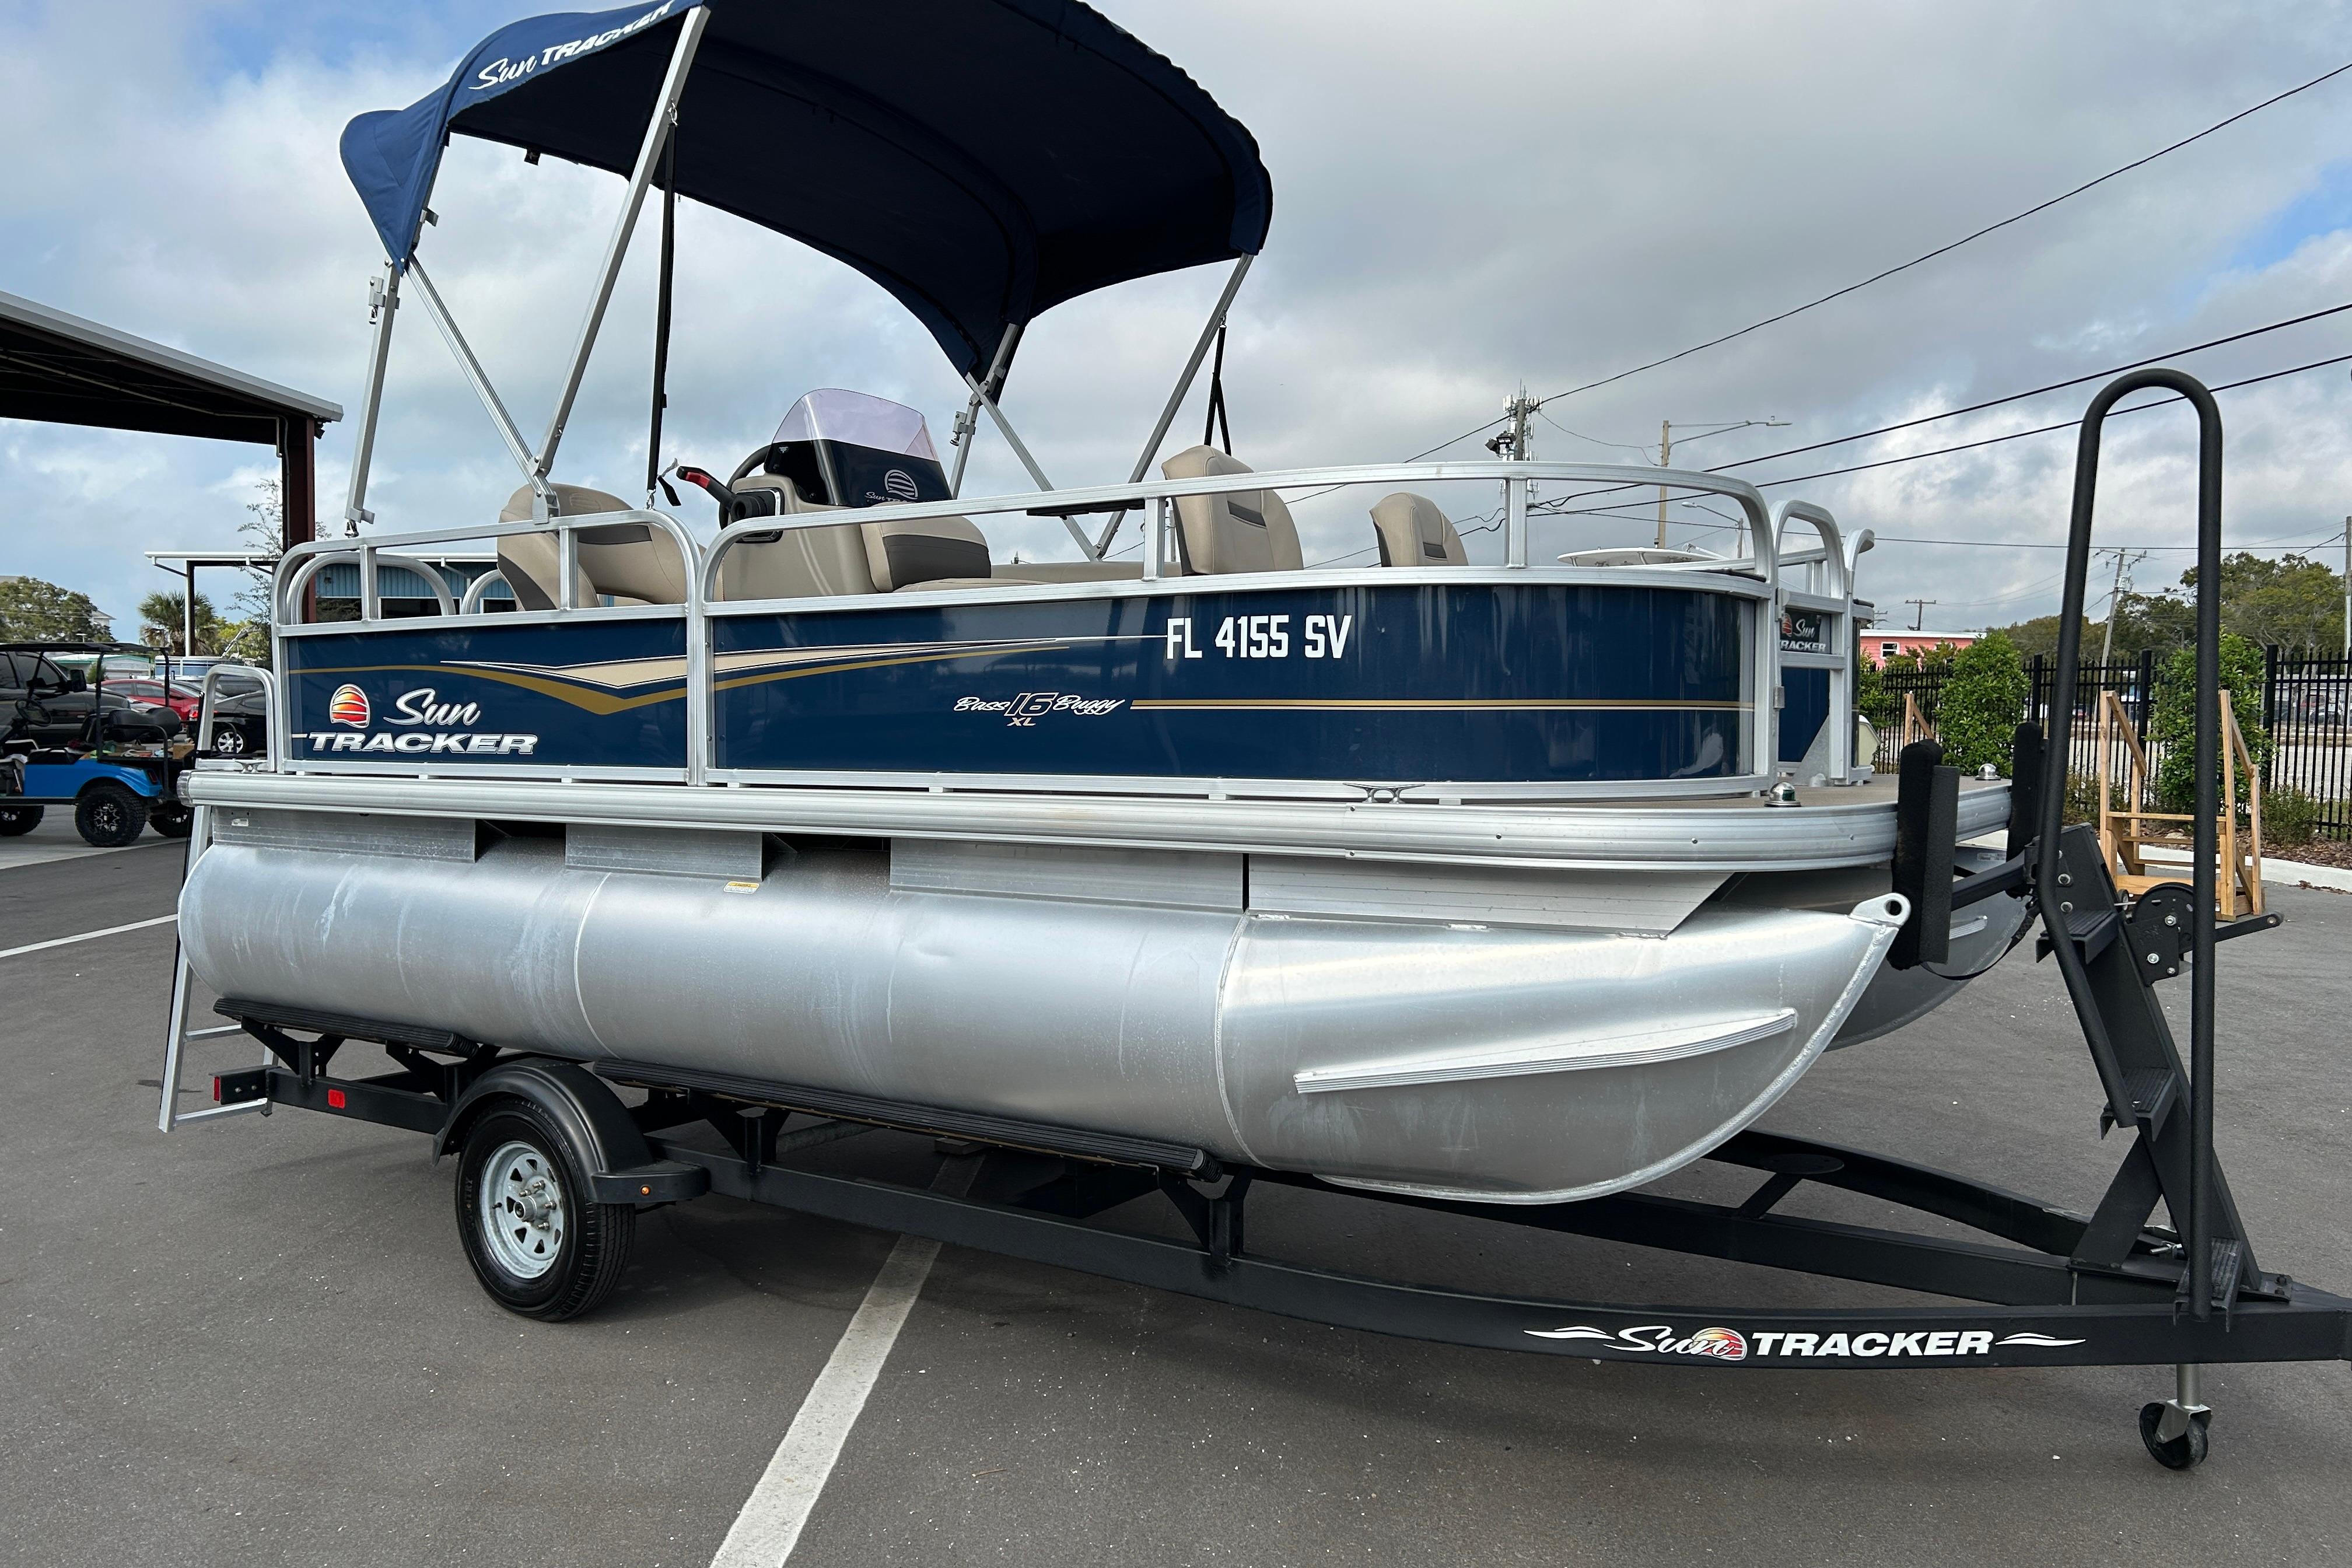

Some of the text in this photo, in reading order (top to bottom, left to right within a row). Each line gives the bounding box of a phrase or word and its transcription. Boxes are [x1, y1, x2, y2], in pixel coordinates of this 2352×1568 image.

[468, 58, 537, 90] Sun
[1167, 615, 1352, 659] FL 4155 SV
[1793, 618, 1815, 638] Sun
[1779, 640, 1826, 652] RACKER
[383, 688, 481, 726] Sun
[953, 692, 1125, 716] Bass 16 Buggy
[1007, 718, 1036, 726] XL
[309, 732, 538, 755] TRACKER
[1603, 1325, 1993, 1356] Sun TRACKER
